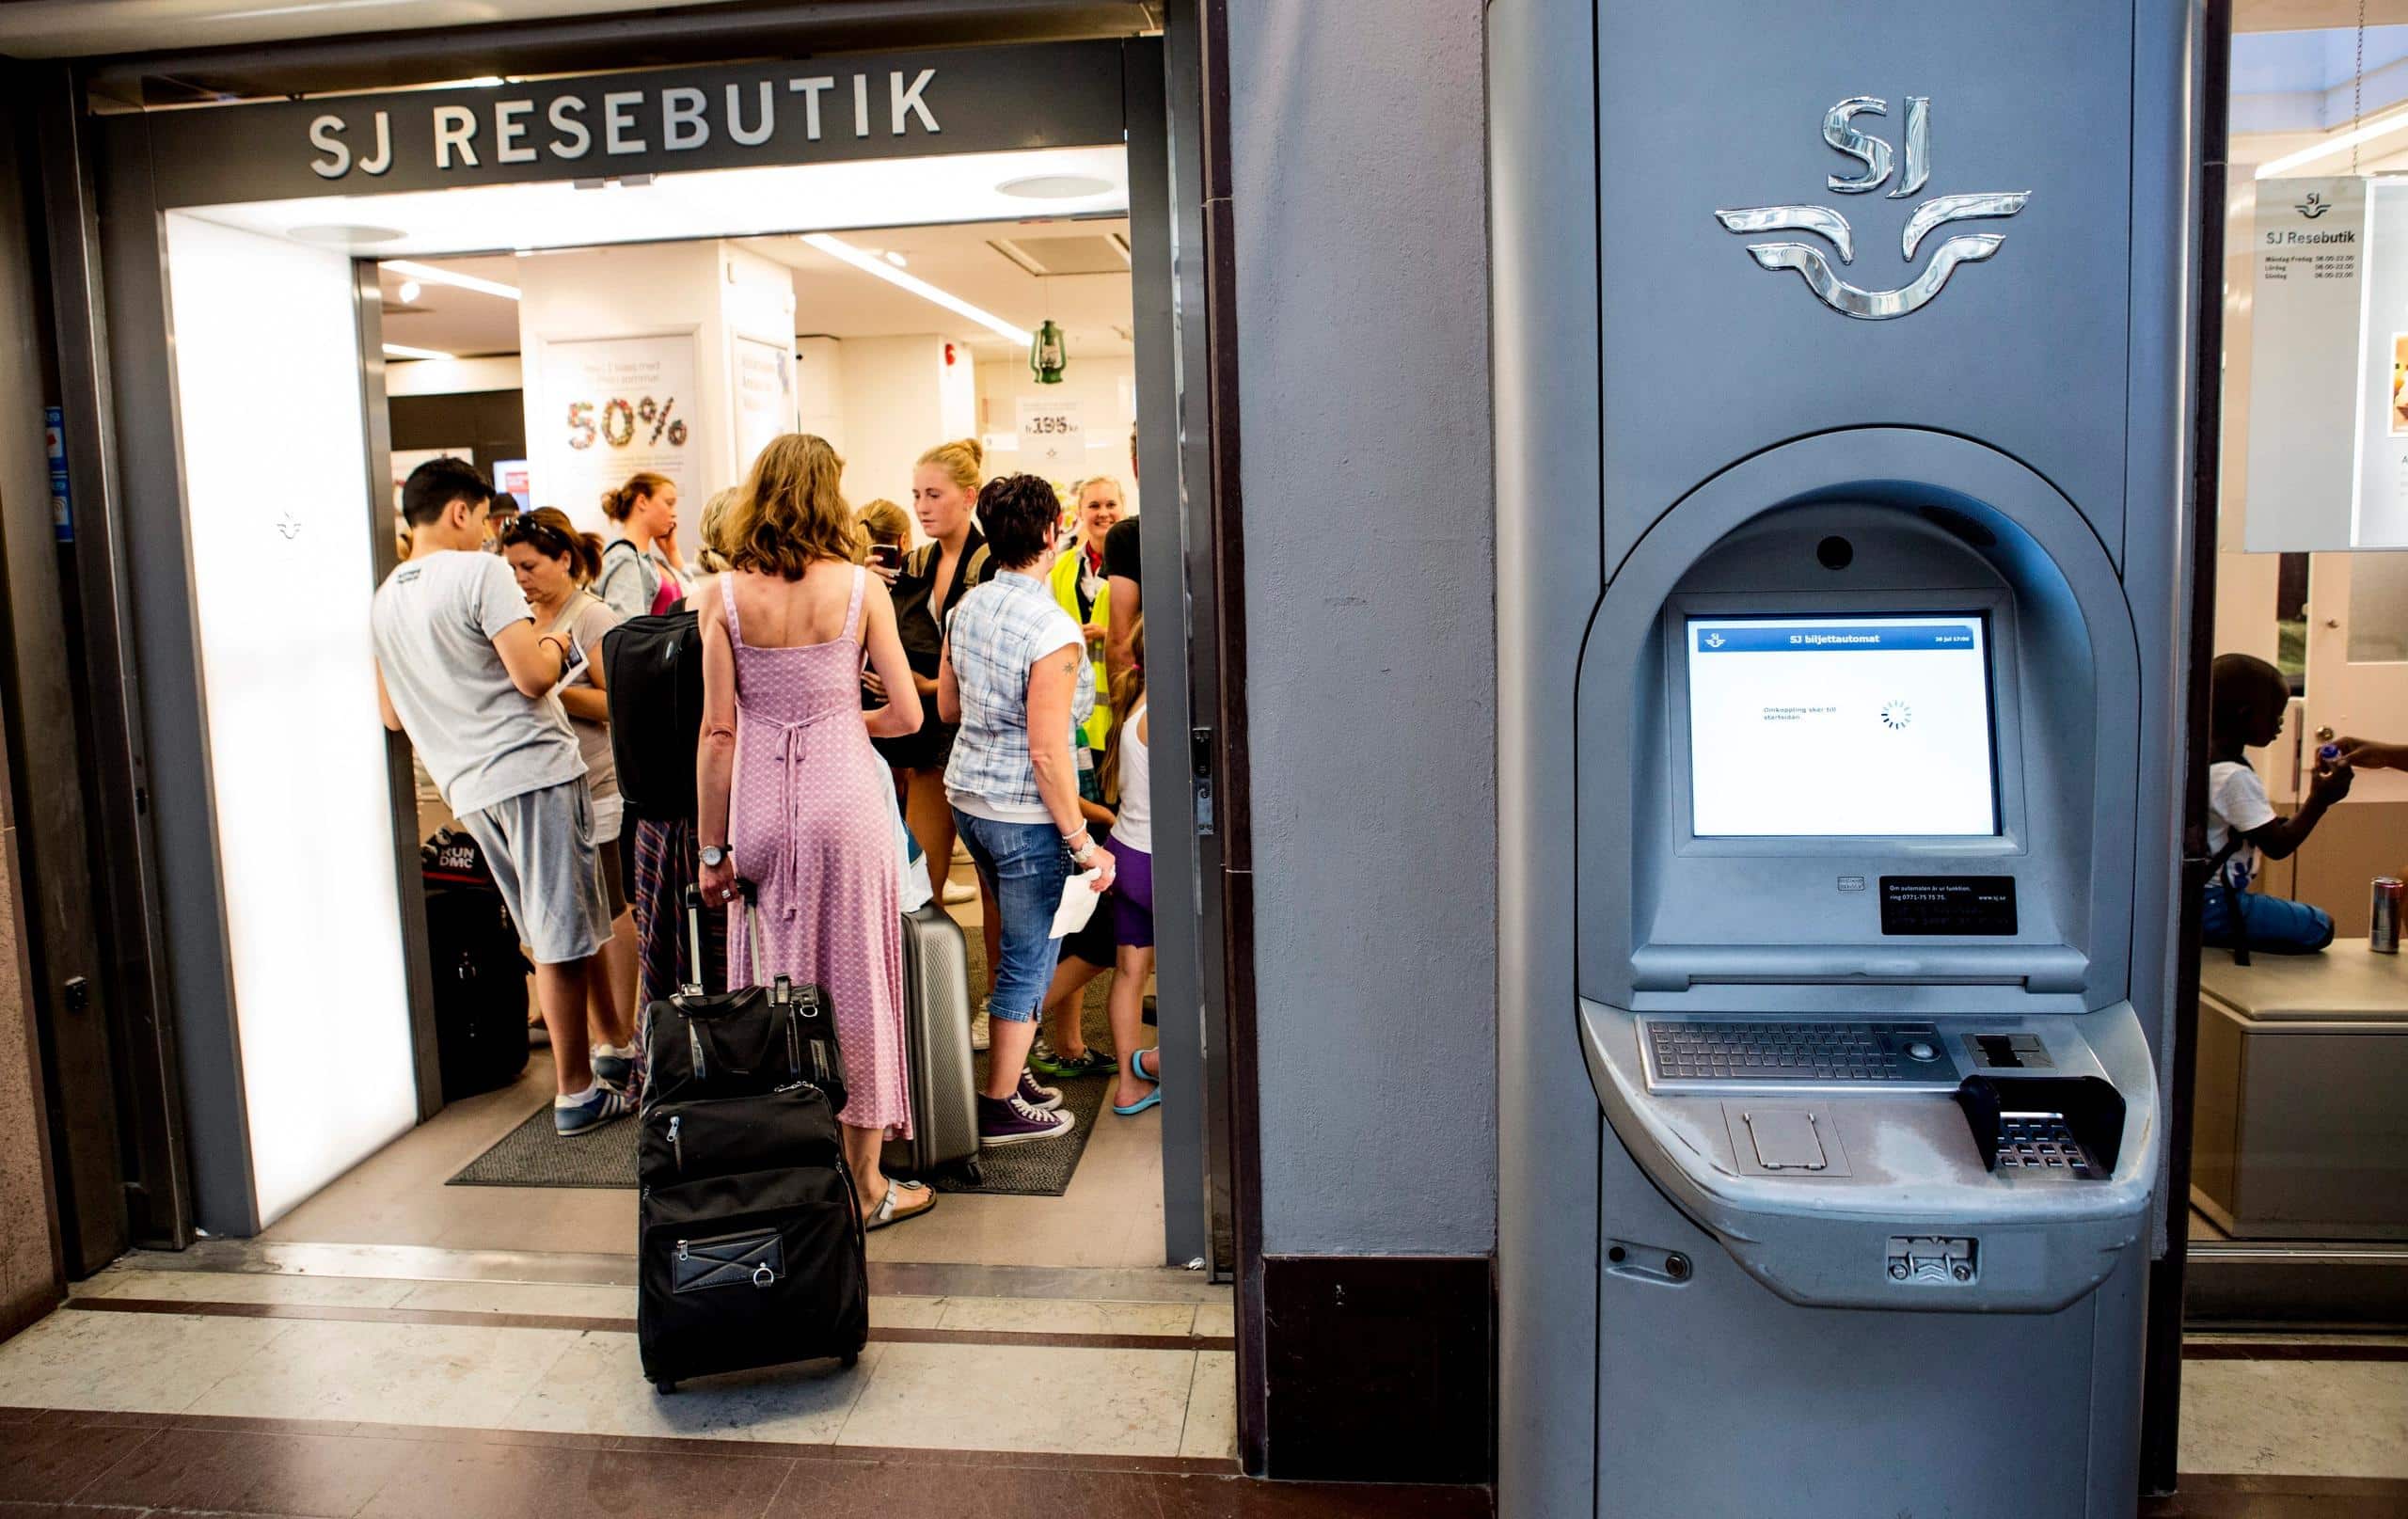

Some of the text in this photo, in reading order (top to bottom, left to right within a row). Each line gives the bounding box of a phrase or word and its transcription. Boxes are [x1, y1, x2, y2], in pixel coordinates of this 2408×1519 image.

[309, 69, 941, 179] SJ RESEBUTIK
[1822, 95, 1930, 198] SJ
[2306, 193, 2321, 205] SJ
[2266, 230, 2355, 245] SJ Resebutik
[566, 395, 688, 451] 50%
[1789, 633, 1880, 645] SJ biljettautomat
[439, 857, 473, 868] DMC
